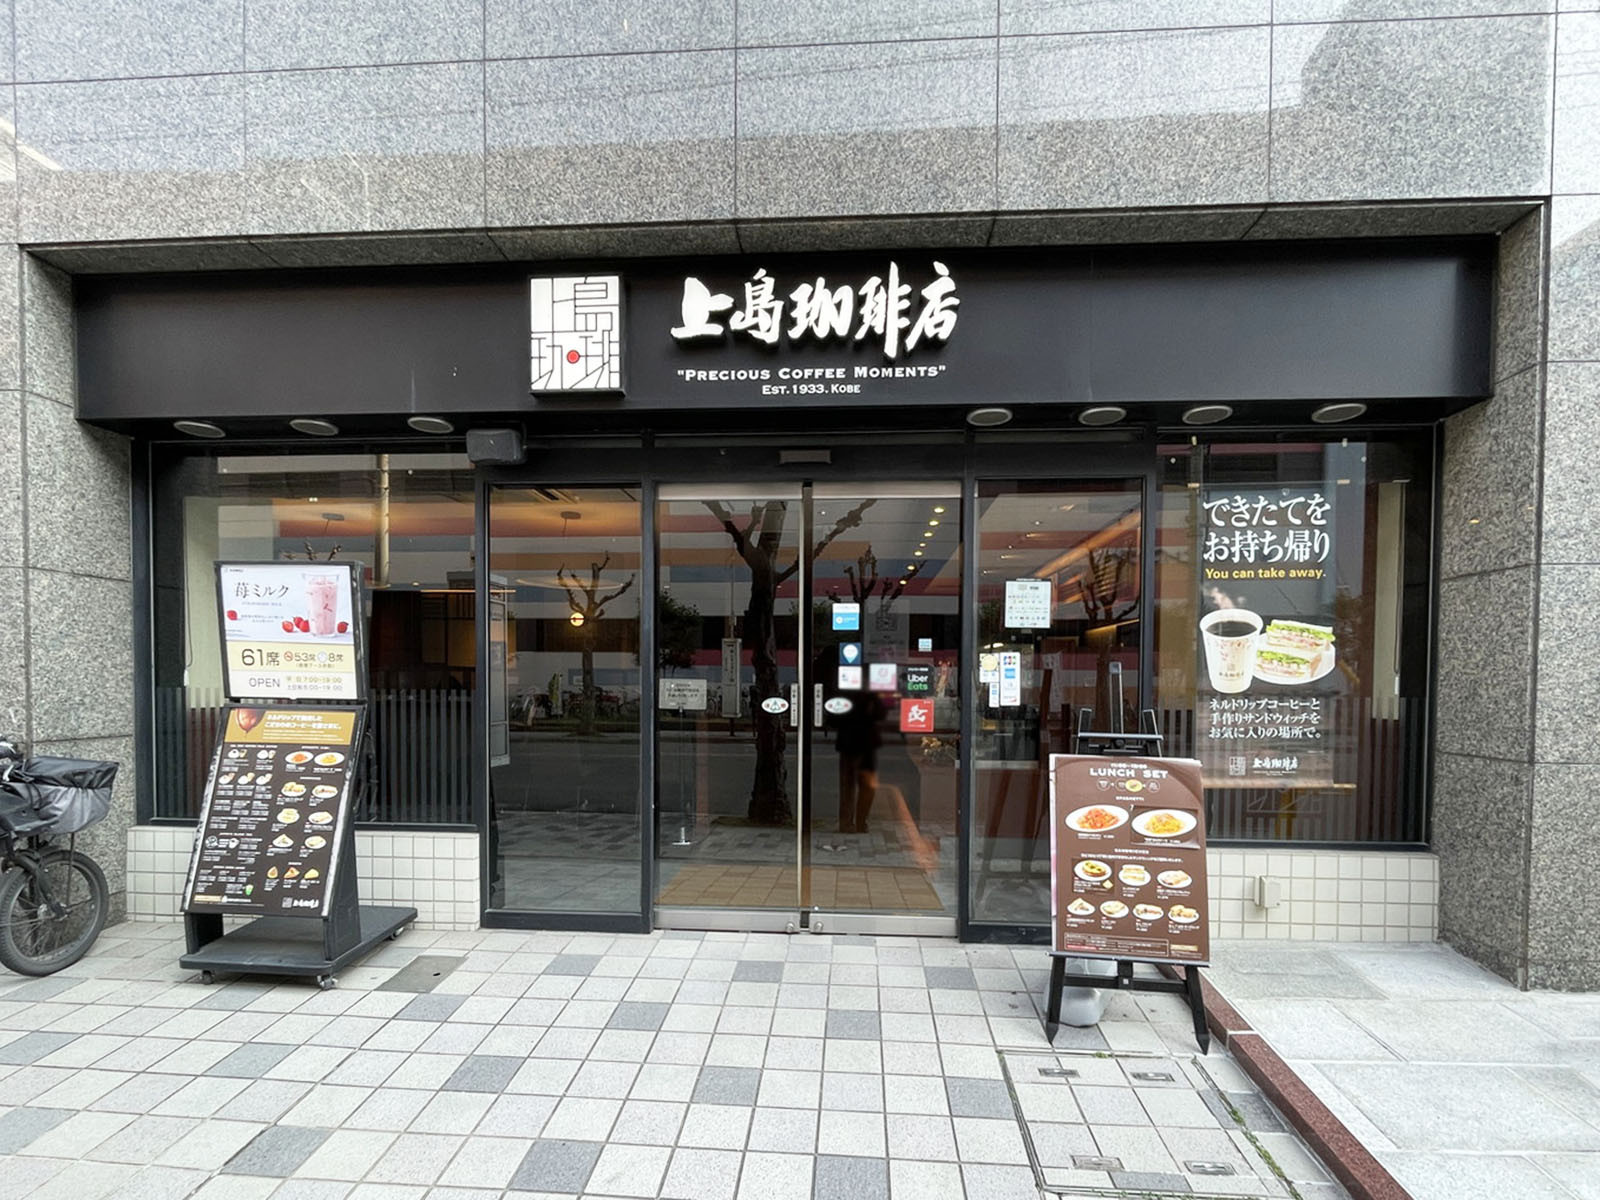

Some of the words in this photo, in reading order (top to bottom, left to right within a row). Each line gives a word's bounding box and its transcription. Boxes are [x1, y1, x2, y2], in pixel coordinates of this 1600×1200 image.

[671, 261, 960, 358] 上島珈琲店
[677, 368, 771, 381] "PRECIOUS
[778, 367, 846, 379] COFFEE
[854, 365, 946, 379] MOMENTS"
[831, 384, 861, 394] KOBE
[1203, 493, 1331, 527] できたてを
[1203, 529, 1330, 563] お持ち帰り
[1205, 568, 1229, 579] You
[1232, 569, 1255, 578] can
[1258, 567, 1286, 578] take
[1289, 569, 1326, 579] away.
[234, 582, 289, 598] 苺ミルク
[248, 677, 280, 688] OPEN
[907, 674, 928, 683] Uber
[907, 682, 928, 690] Eats
[1209, 698, 1320, 711] ネルドリップコーヒーと
[1210, 712, 1320, 725] 手作りサンドウィッチを
[1208, 726, 1321, 739] お気に入りの場所で。
[1089, 767, 1135, 778] LUNCH
[1142, 769, 1169, 779] SET
